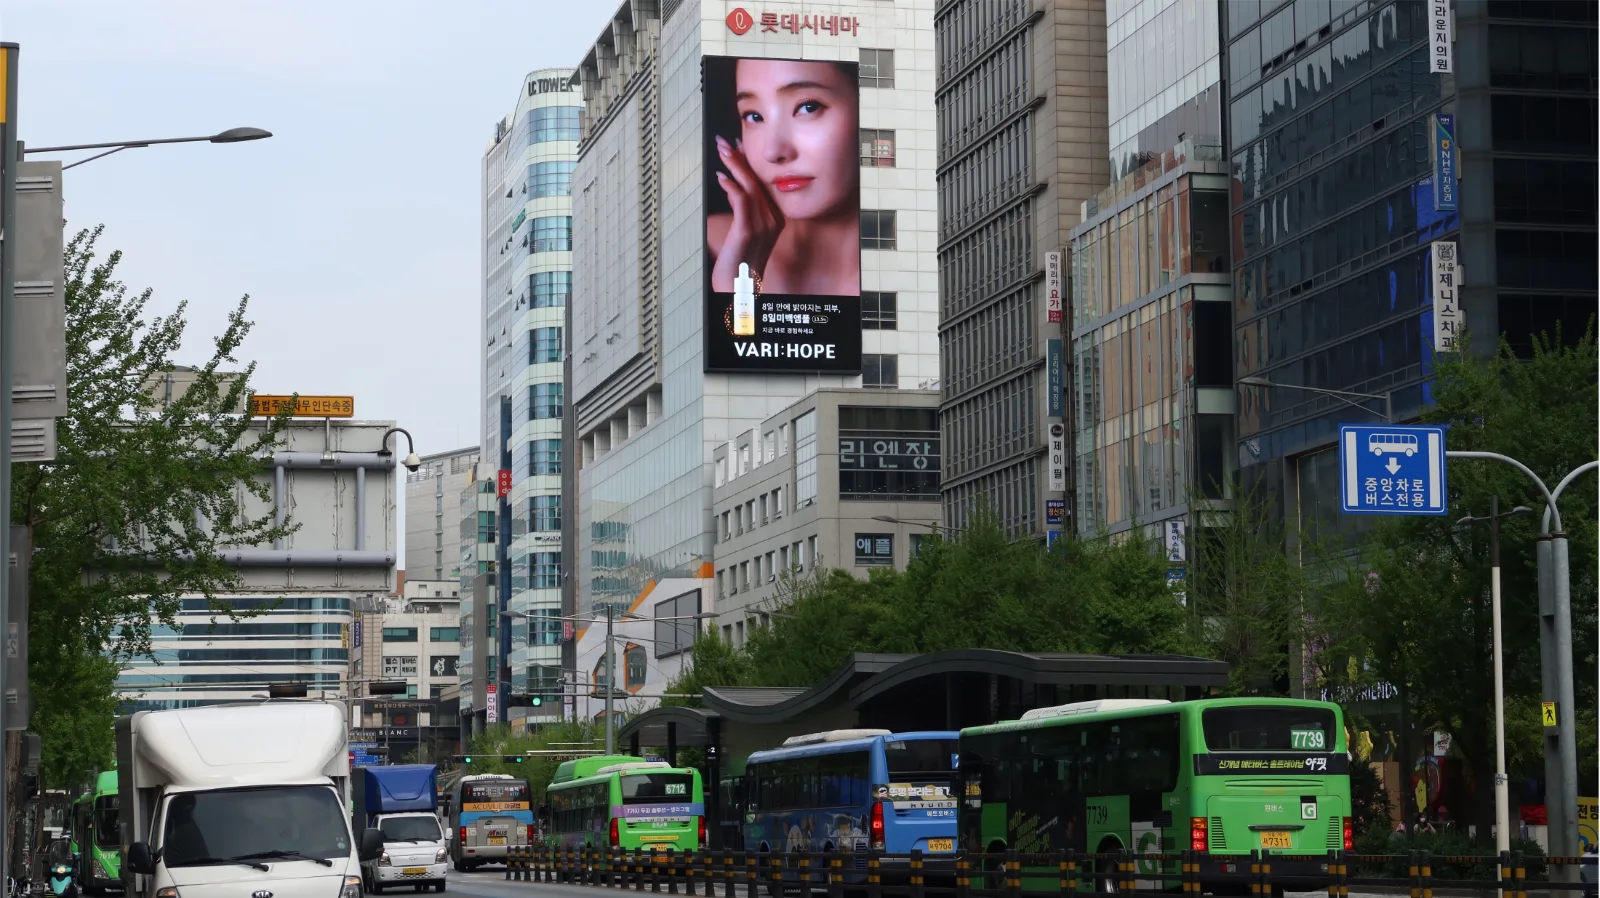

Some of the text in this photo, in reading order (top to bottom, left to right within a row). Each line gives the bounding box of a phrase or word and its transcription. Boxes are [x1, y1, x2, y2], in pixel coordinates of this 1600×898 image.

[760, 12, 860, 36] 롯데시네마
[1442, 150, 1452, 202] NH투자증권
[1050, 254, 1059, 288] 아메리카
[1438, 262, 1454, 272] 서울
[1050, 289, 1060, 309] 요가
[762, 303, 841, 313] 8일 만에 밝아지는 피부,
[1440, 273, 1455, 348] 제니스치과
[762, 314, 810, 324] 8일미백앰플
[734, 342, 836, 359] VARI:HOPE
[841, 440, 930, 470] 리엔장
[1053, 440, 1062, 480] 제이필
[1365, 477, 1425, 492] 중앙차로
[1366, 492, 1425, 508] 버스전용
[857, 538, 890, 554] 애플
[1292, 732, 1324, 748] 7739
[1219, 760, 1240, 769] 신개념
[1241, 760, 1269, 769] 메타버스
[666, 785, 685, 794] 6712
[1086, 806, 1108, 824] 7739
[1304, 805, 1314, 817] G
